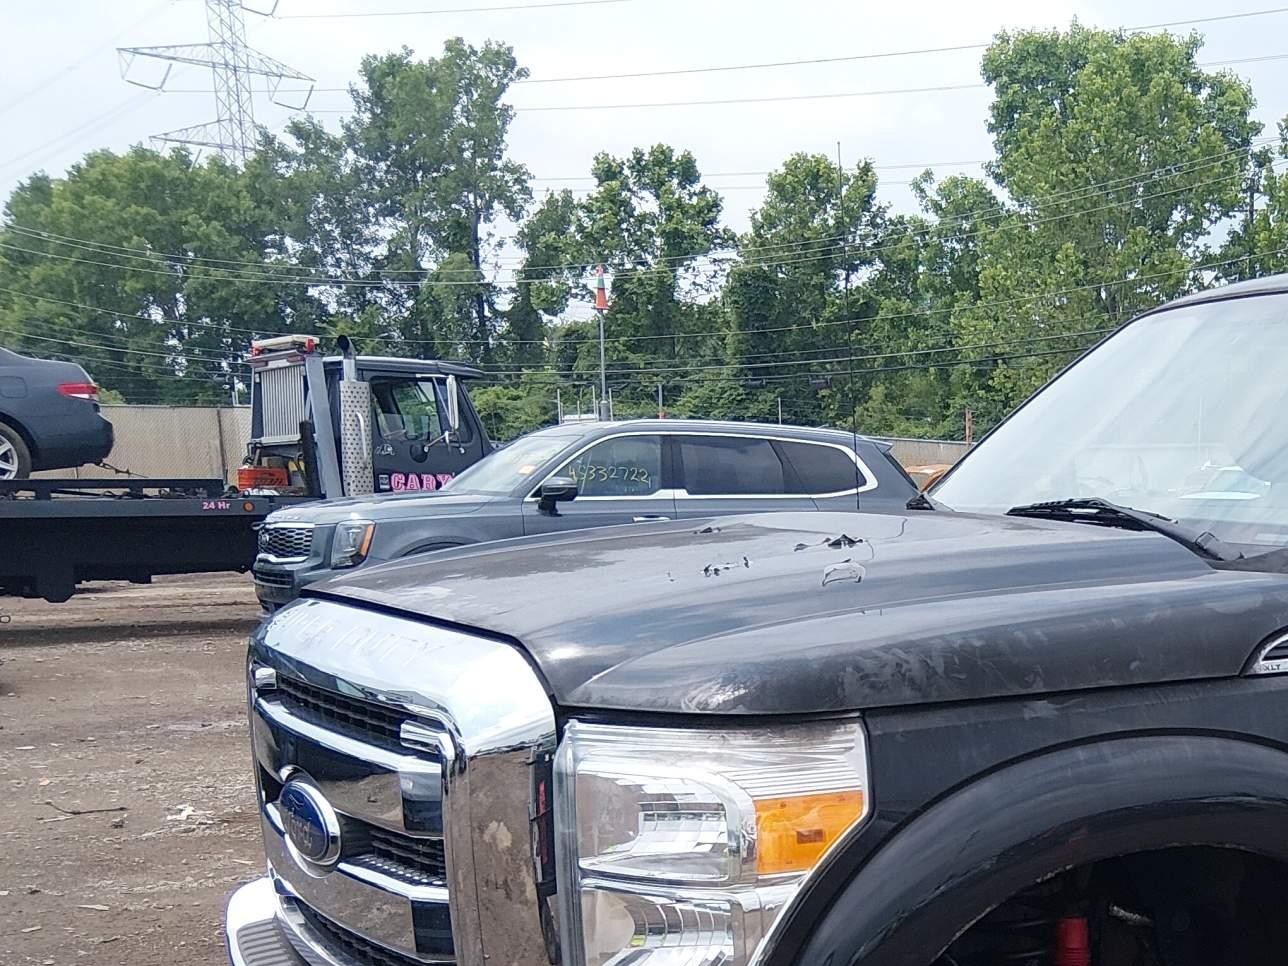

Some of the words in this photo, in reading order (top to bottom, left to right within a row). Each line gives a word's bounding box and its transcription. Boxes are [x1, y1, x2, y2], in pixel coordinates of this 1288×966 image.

[202, 501, 215, 510] 24
[217, 501, 231, 510] Hr
[1263, 663, 1281, 672] XLT
